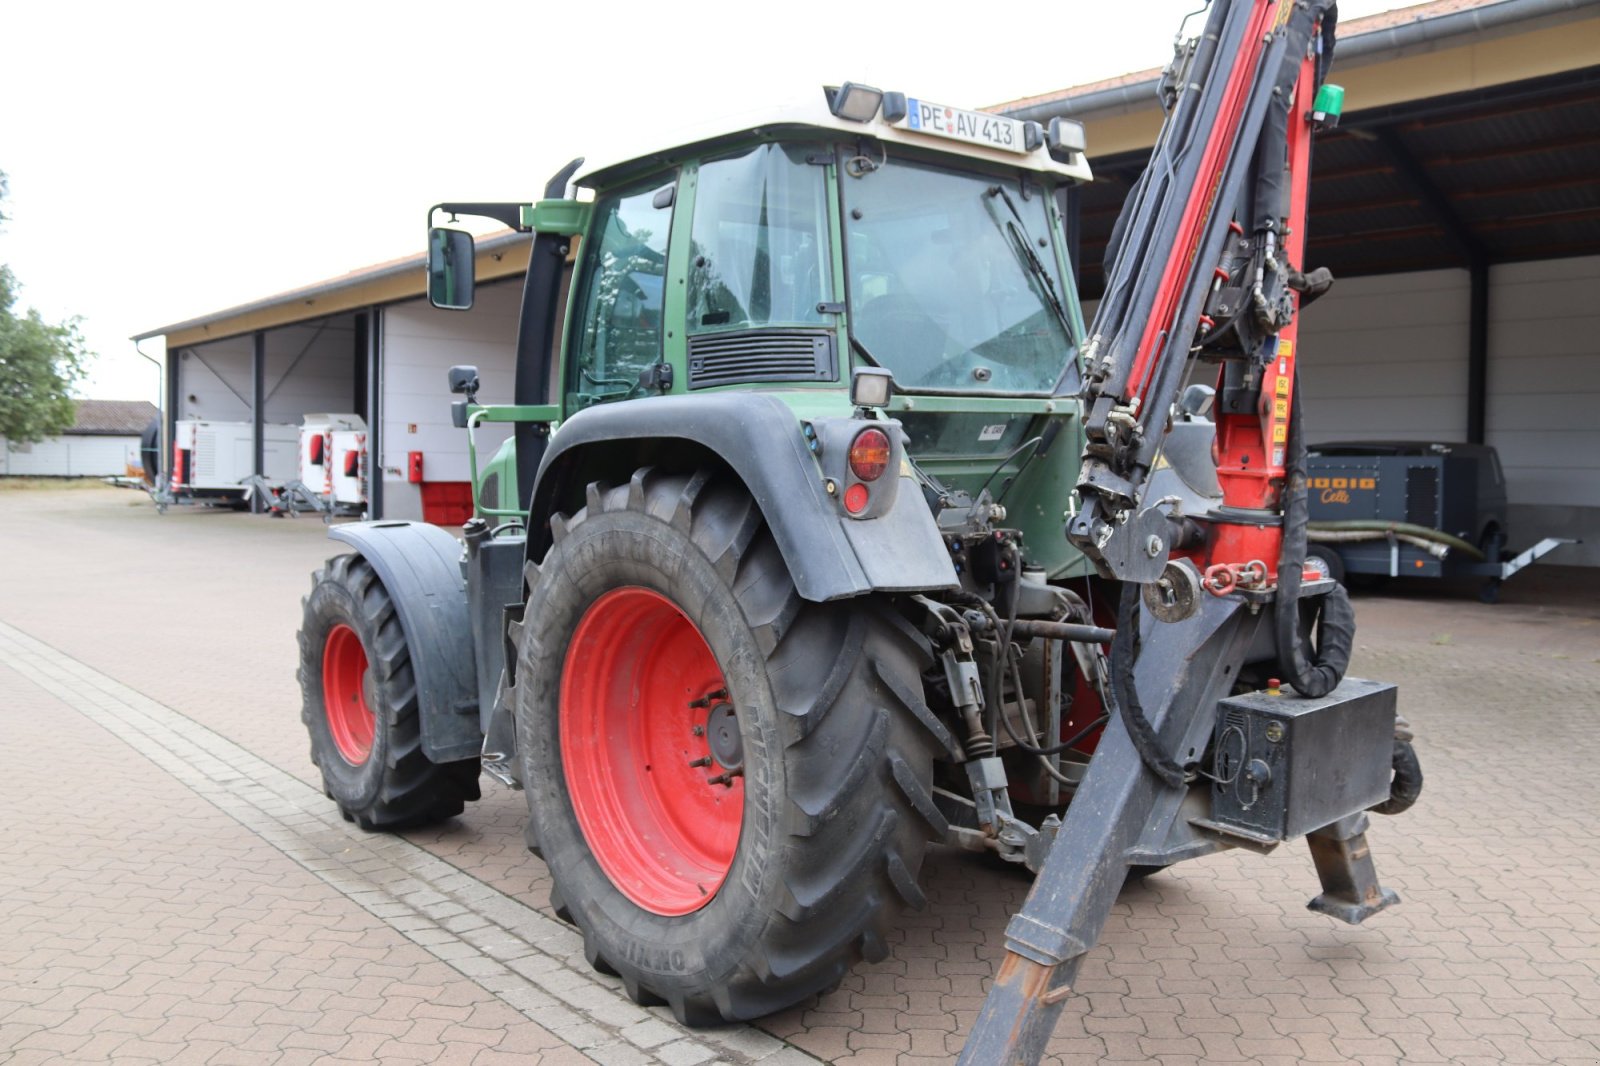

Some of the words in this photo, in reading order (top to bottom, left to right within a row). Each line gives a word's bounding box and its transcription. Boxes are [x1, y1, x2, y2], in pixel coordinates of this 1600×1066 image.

[920, 104, 944, 131] PE
[957, 112, 977, 138] AV
[982, 119, 1012, 145] 413
[742, 705, 772, 900] MICHELIN
